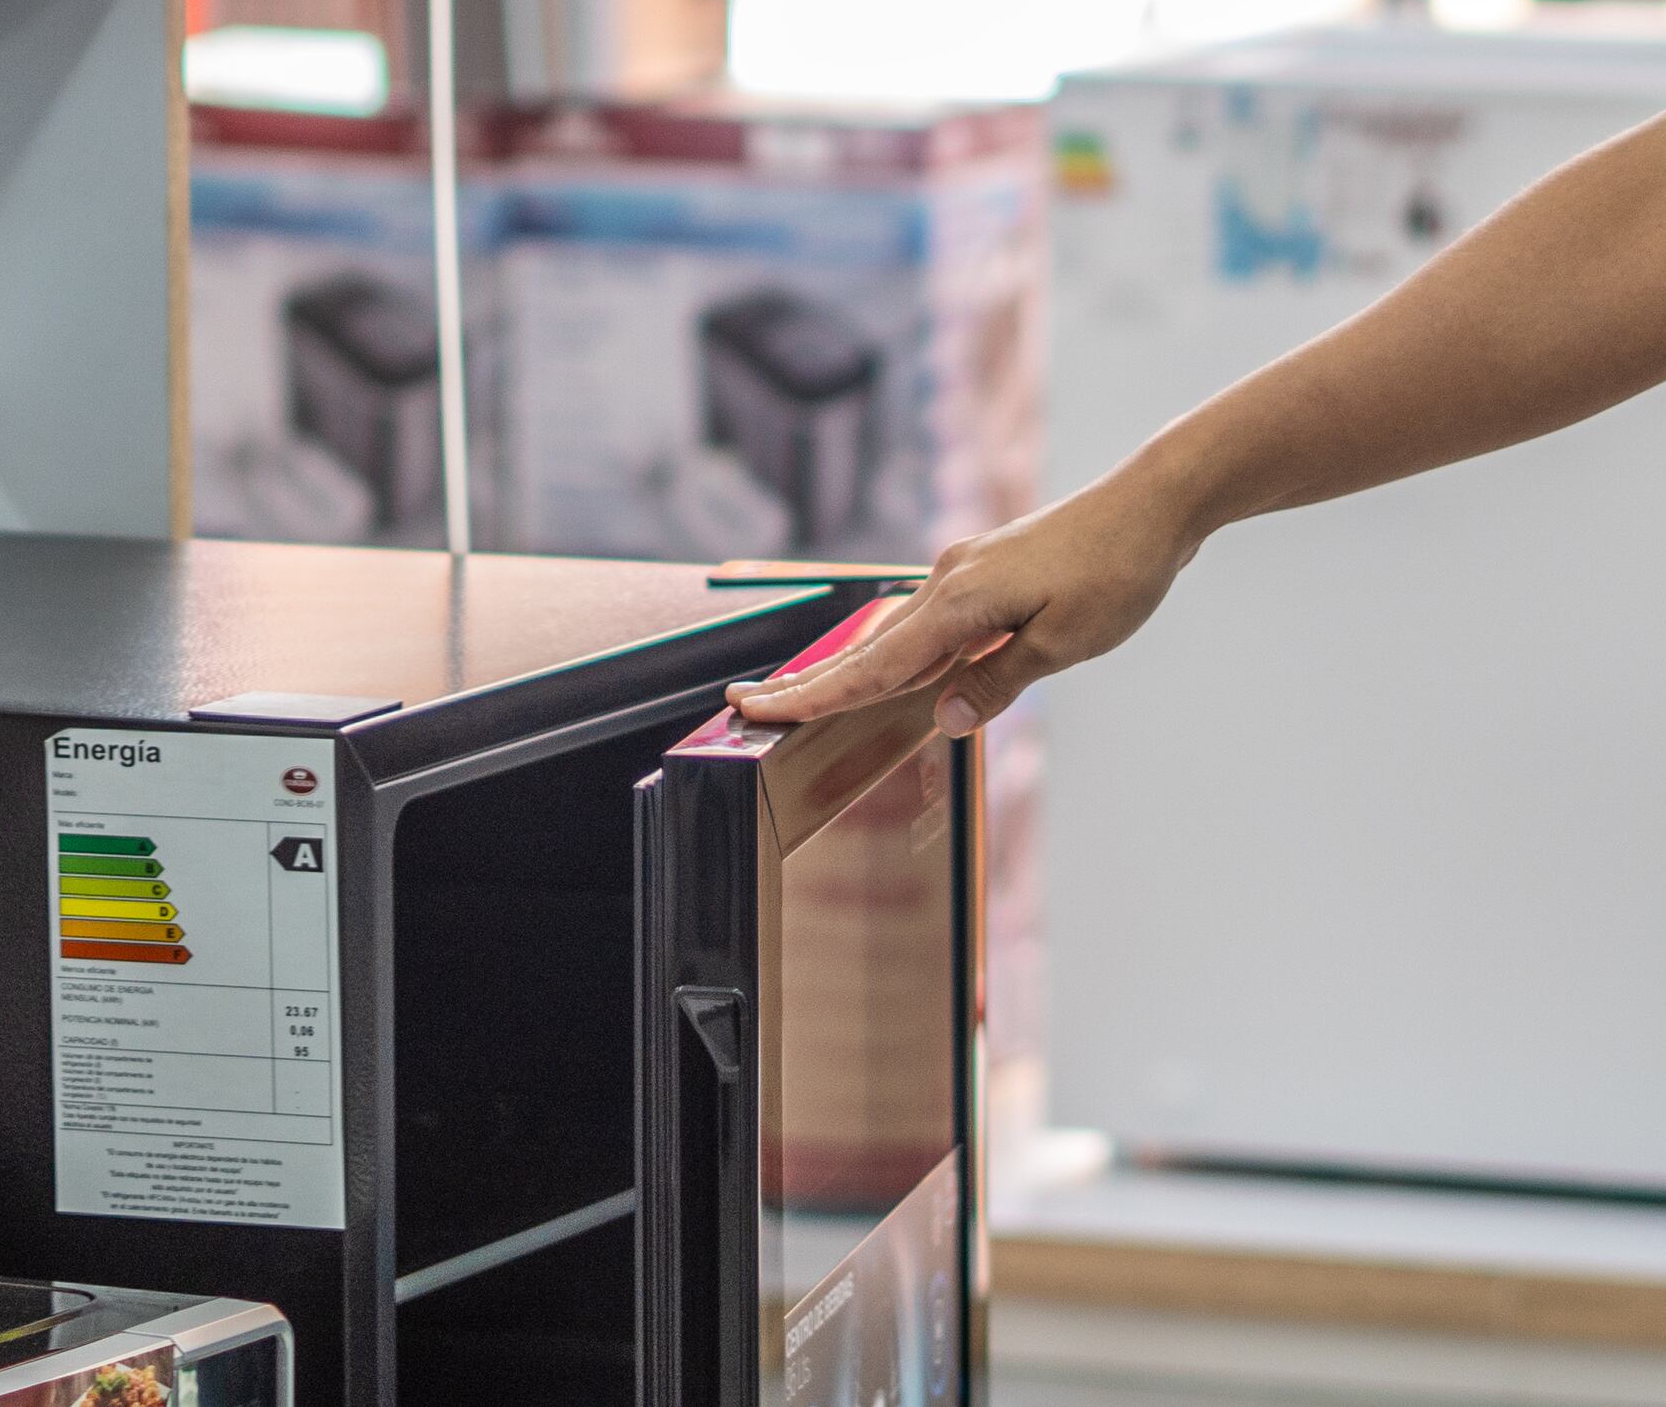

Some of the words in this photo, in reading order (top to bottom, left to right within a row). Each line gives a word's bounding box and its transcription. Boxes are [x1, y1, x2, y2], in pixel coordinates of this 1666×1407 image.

[53, 736, 161, 767] Energía
[293, 842, 318, 869] A
[152, 884, 162, 895] C
[159, 906, 169, 917] D
[166, 927, 176, 939] E
[173, 949, 182, 960] F
[293, 1045, 310, 1058] 95
